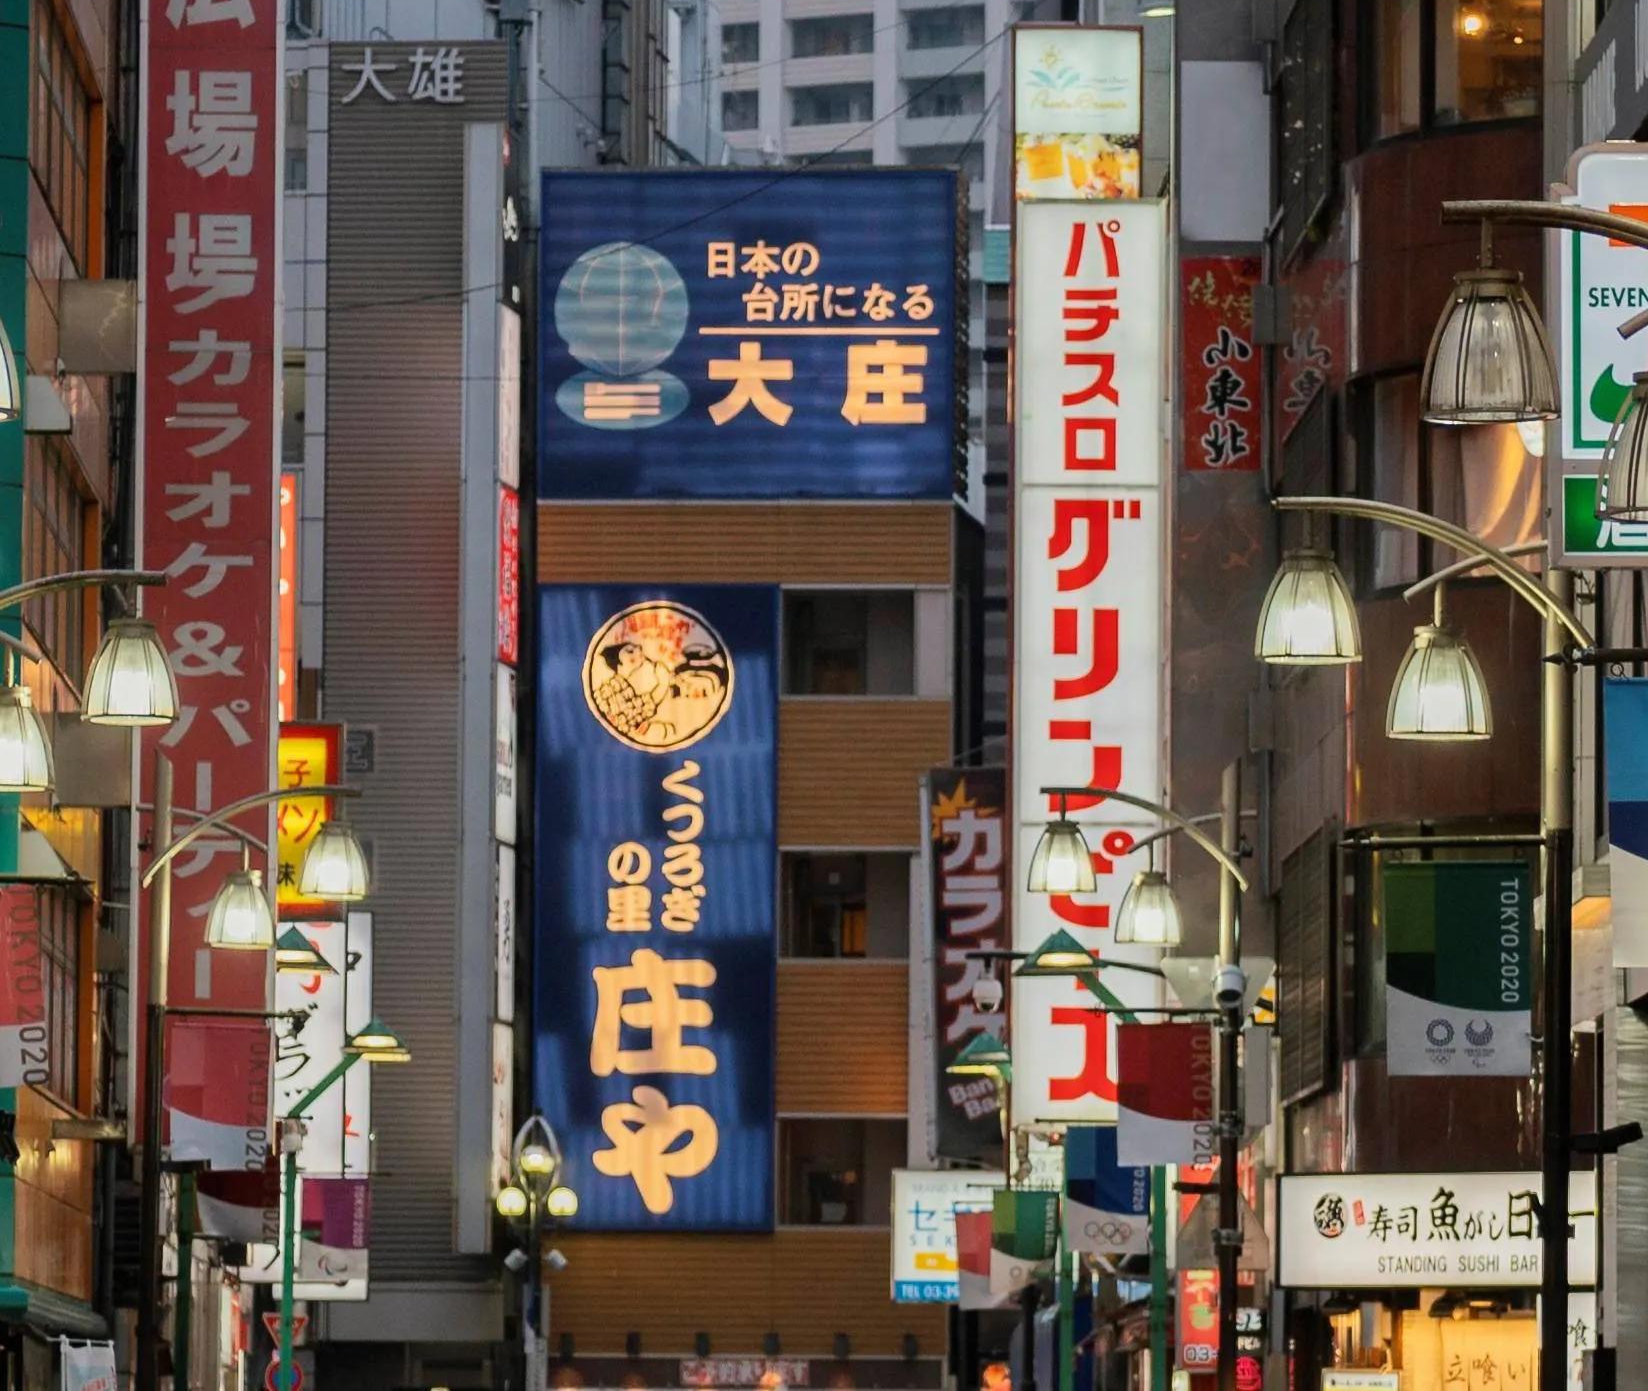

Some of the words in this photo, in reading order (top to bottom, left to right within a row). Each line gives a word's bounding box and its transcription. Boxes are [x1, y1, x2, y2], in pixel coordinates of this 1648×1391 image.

[341, 47, 466, 105] 大雄
[706, 241, 820, 280] 日本の
[741, 282, 935, 323] 台所になる
[707, 339, 929, 427] 大庄
[1201, 324, 1253, 468] 小東北
[1047, 498, 1141, 1105] グリンピス
[606, 840, 651, 933] の里
[660, 760, 705, 934] くつろぎ
[1500, 877, 1520, 948] TOKYO
[1500, 952, 1520, 1004] 2020
[17, 1005, 51, 1086] 2020
[589, 947, 720, 1215] 庄や
[1377, 1254, 1448, 1274] STANDING
[1458, 1254, 1501, 1274] SUSHI
[1510, 1254, 1540, 1274] BAR
